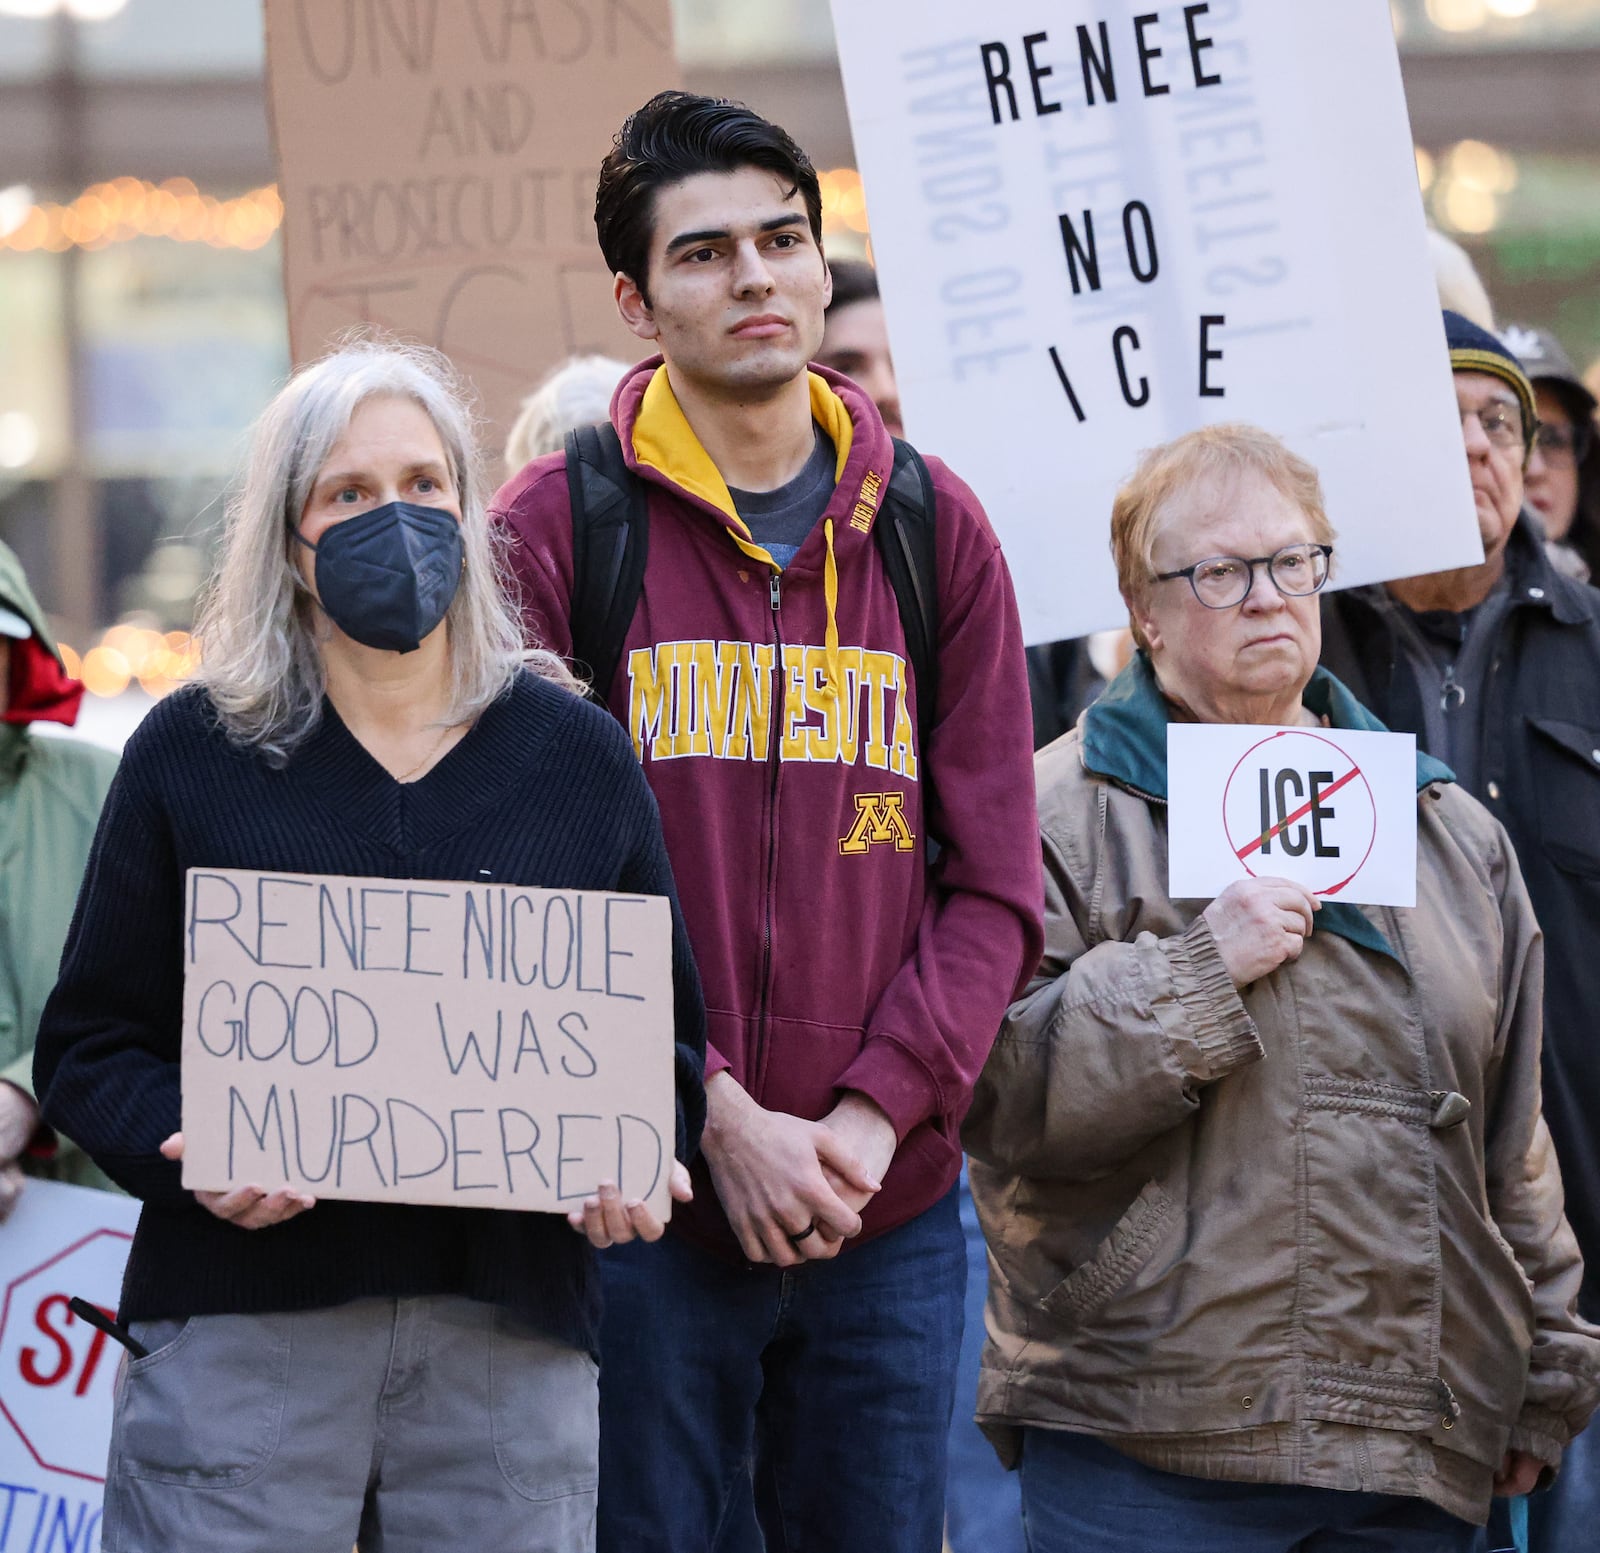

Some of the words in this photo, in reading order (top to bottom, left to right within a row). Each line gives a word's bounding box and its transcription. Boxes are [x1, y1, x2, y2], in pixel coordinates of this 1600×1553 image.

[980, 3, 1222, 125] RENEE
[418, 81, 537, 162] AND
[1058, 200, 1159, 296] NO
[1048, 314, 1225, 423] ICE
[627, 640, 918, 782] MINNESOTA
[838, 791, 916, 856] M
[1259, 768, 1340, 858] ICE
[188, 873, 450, 976] RENEE
[463, 887, 647, 1001] NICOLE
[198, 980, 379, 1068] GOOD
[436, 1002, 597, 1081] WAS
[229, 1084, 662, 1202] MURDERED
